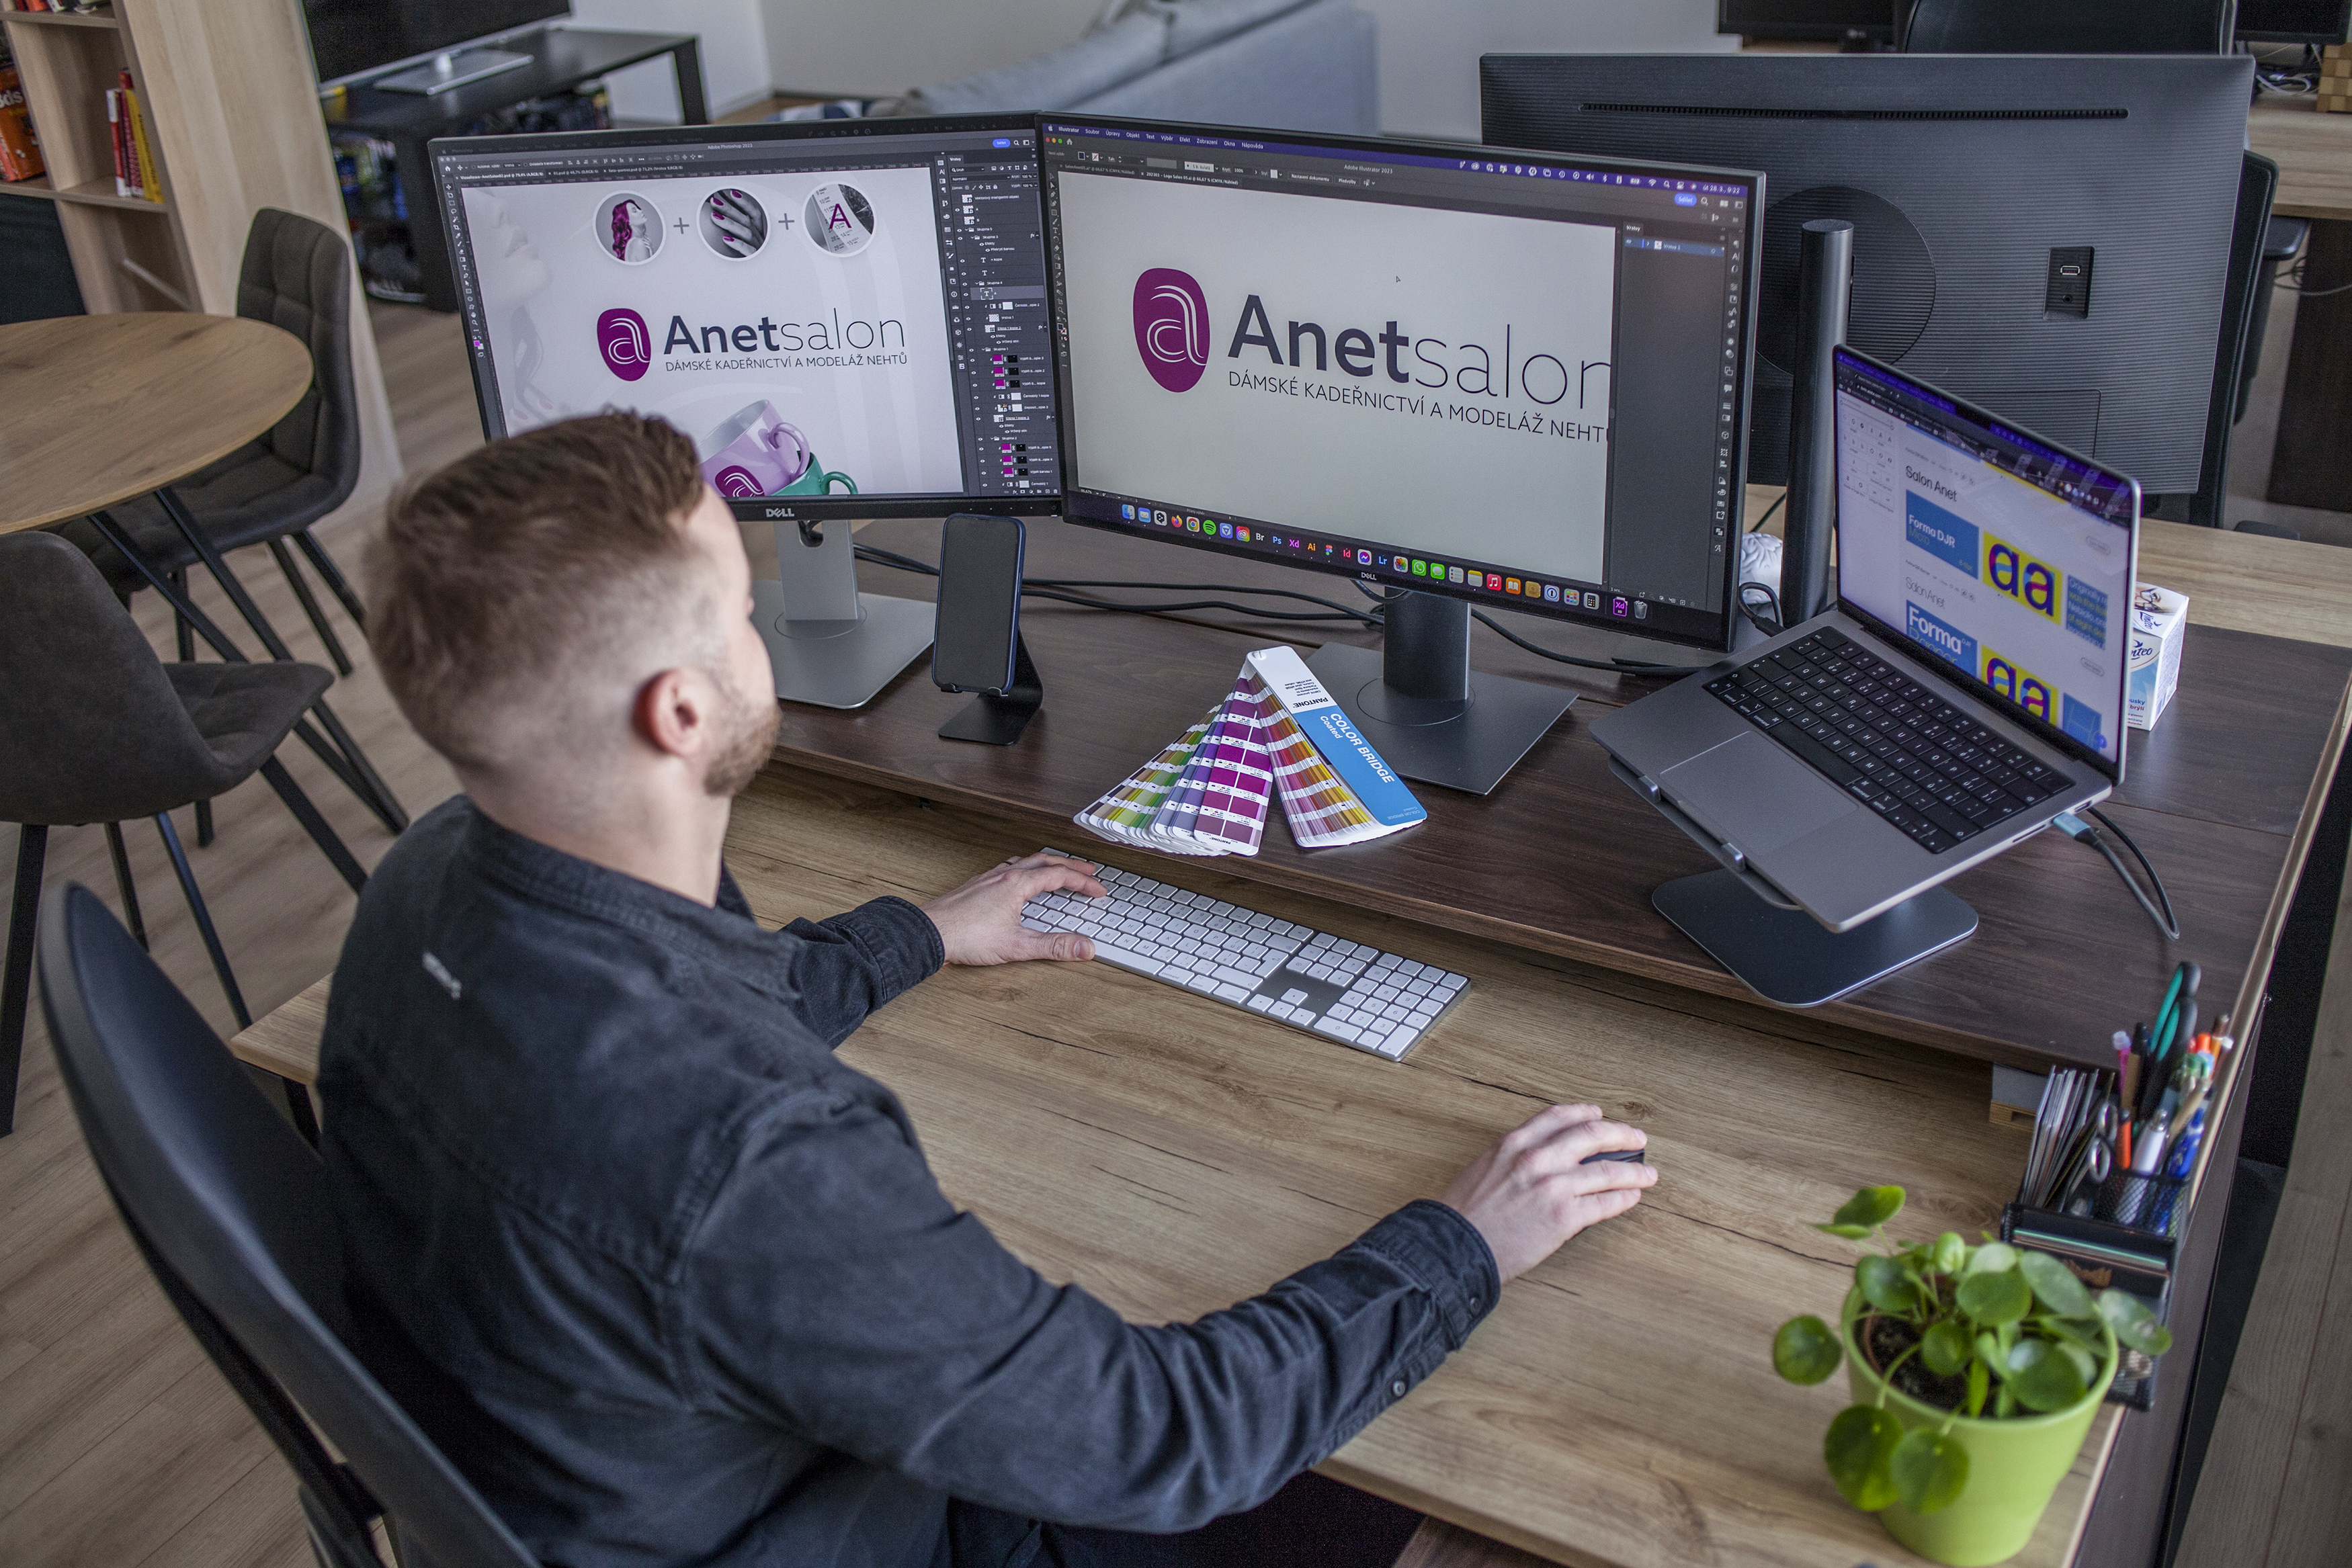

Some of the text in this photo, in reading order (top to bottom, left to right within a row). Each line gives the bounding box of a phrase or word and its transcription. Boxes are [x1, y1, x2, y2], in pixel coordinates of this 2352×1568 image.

[829, 204, 852, 229] A
[1626, 224, 1640, 232] Vrstvy
[664, 308, 905, 355] Anetsalon
[666, 351, 907, 372] DÁMSKÉ KADEŘNICTVÍ A MODELÁŽ NEHTŮ
[1229, 369, 1608, 443] DÁMSKÉ KADEŘNICTVÍ A MODELÁŽ NEHT
[1906, 466, 1957, 502] Salon Anet
[765, 508, 794, 518] DELL
[1908, 514, 1956, 548] Forma DJR
[1255, 533, 1388, 565] Br Ps Xd Ai Id Lr
[1361, 572, 1377, 580] DELL
[1906, 577, 1927, 599] Salon
[1615, 601, 1625, 609] Xd
[1908, 605, 1962, 655] Forma
[1961, 638, 1972, 647] DJR
[2140, 611, 2154, 629] Linteo
[2131, 647, 2153, 660] nteo
[1320, 715, 1343, 739] Coated
[1753, 715, 1770, 726] command
[1331, 713, 1395, 783] COLOR BRIDGE
[1212, 836, 1231, 844] PANTONE
[1161, 971, 1180, 979] command
